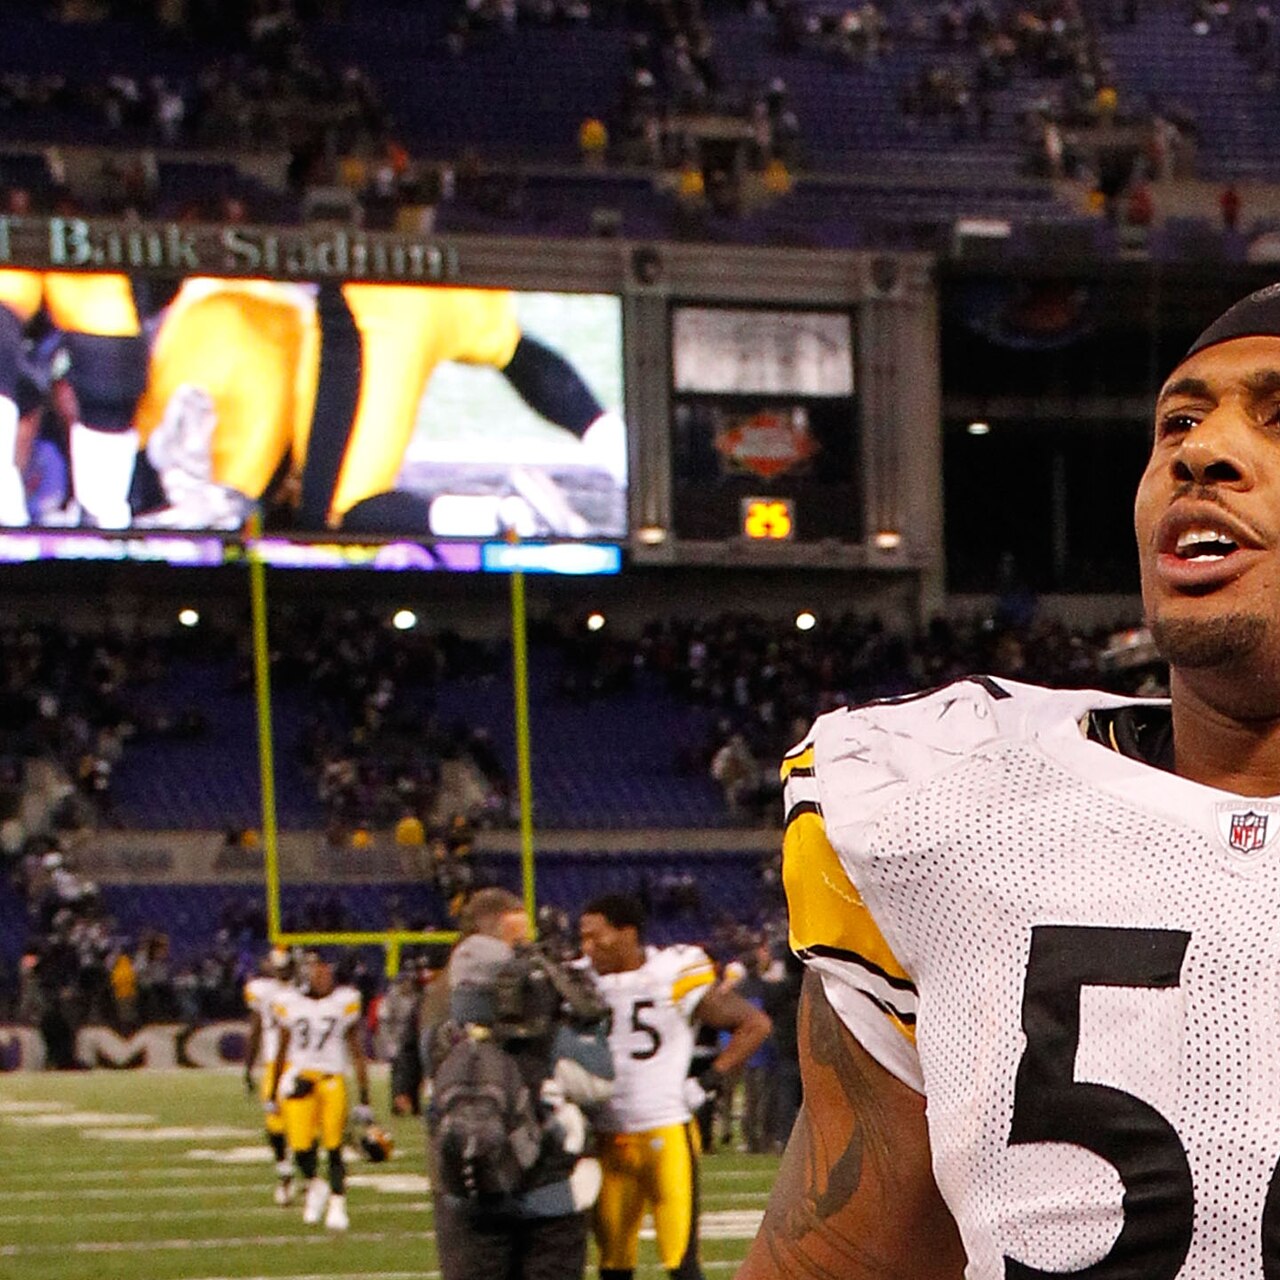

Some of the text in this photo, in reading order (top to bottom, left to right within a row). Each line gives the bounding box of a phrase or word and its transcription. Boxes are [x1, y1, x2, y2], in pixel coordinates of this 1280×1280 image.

[51, 216, 200, 268] Bank
[223, 228, 461, 277] Stadium
[1233, 826, 1263, 848] NFL
